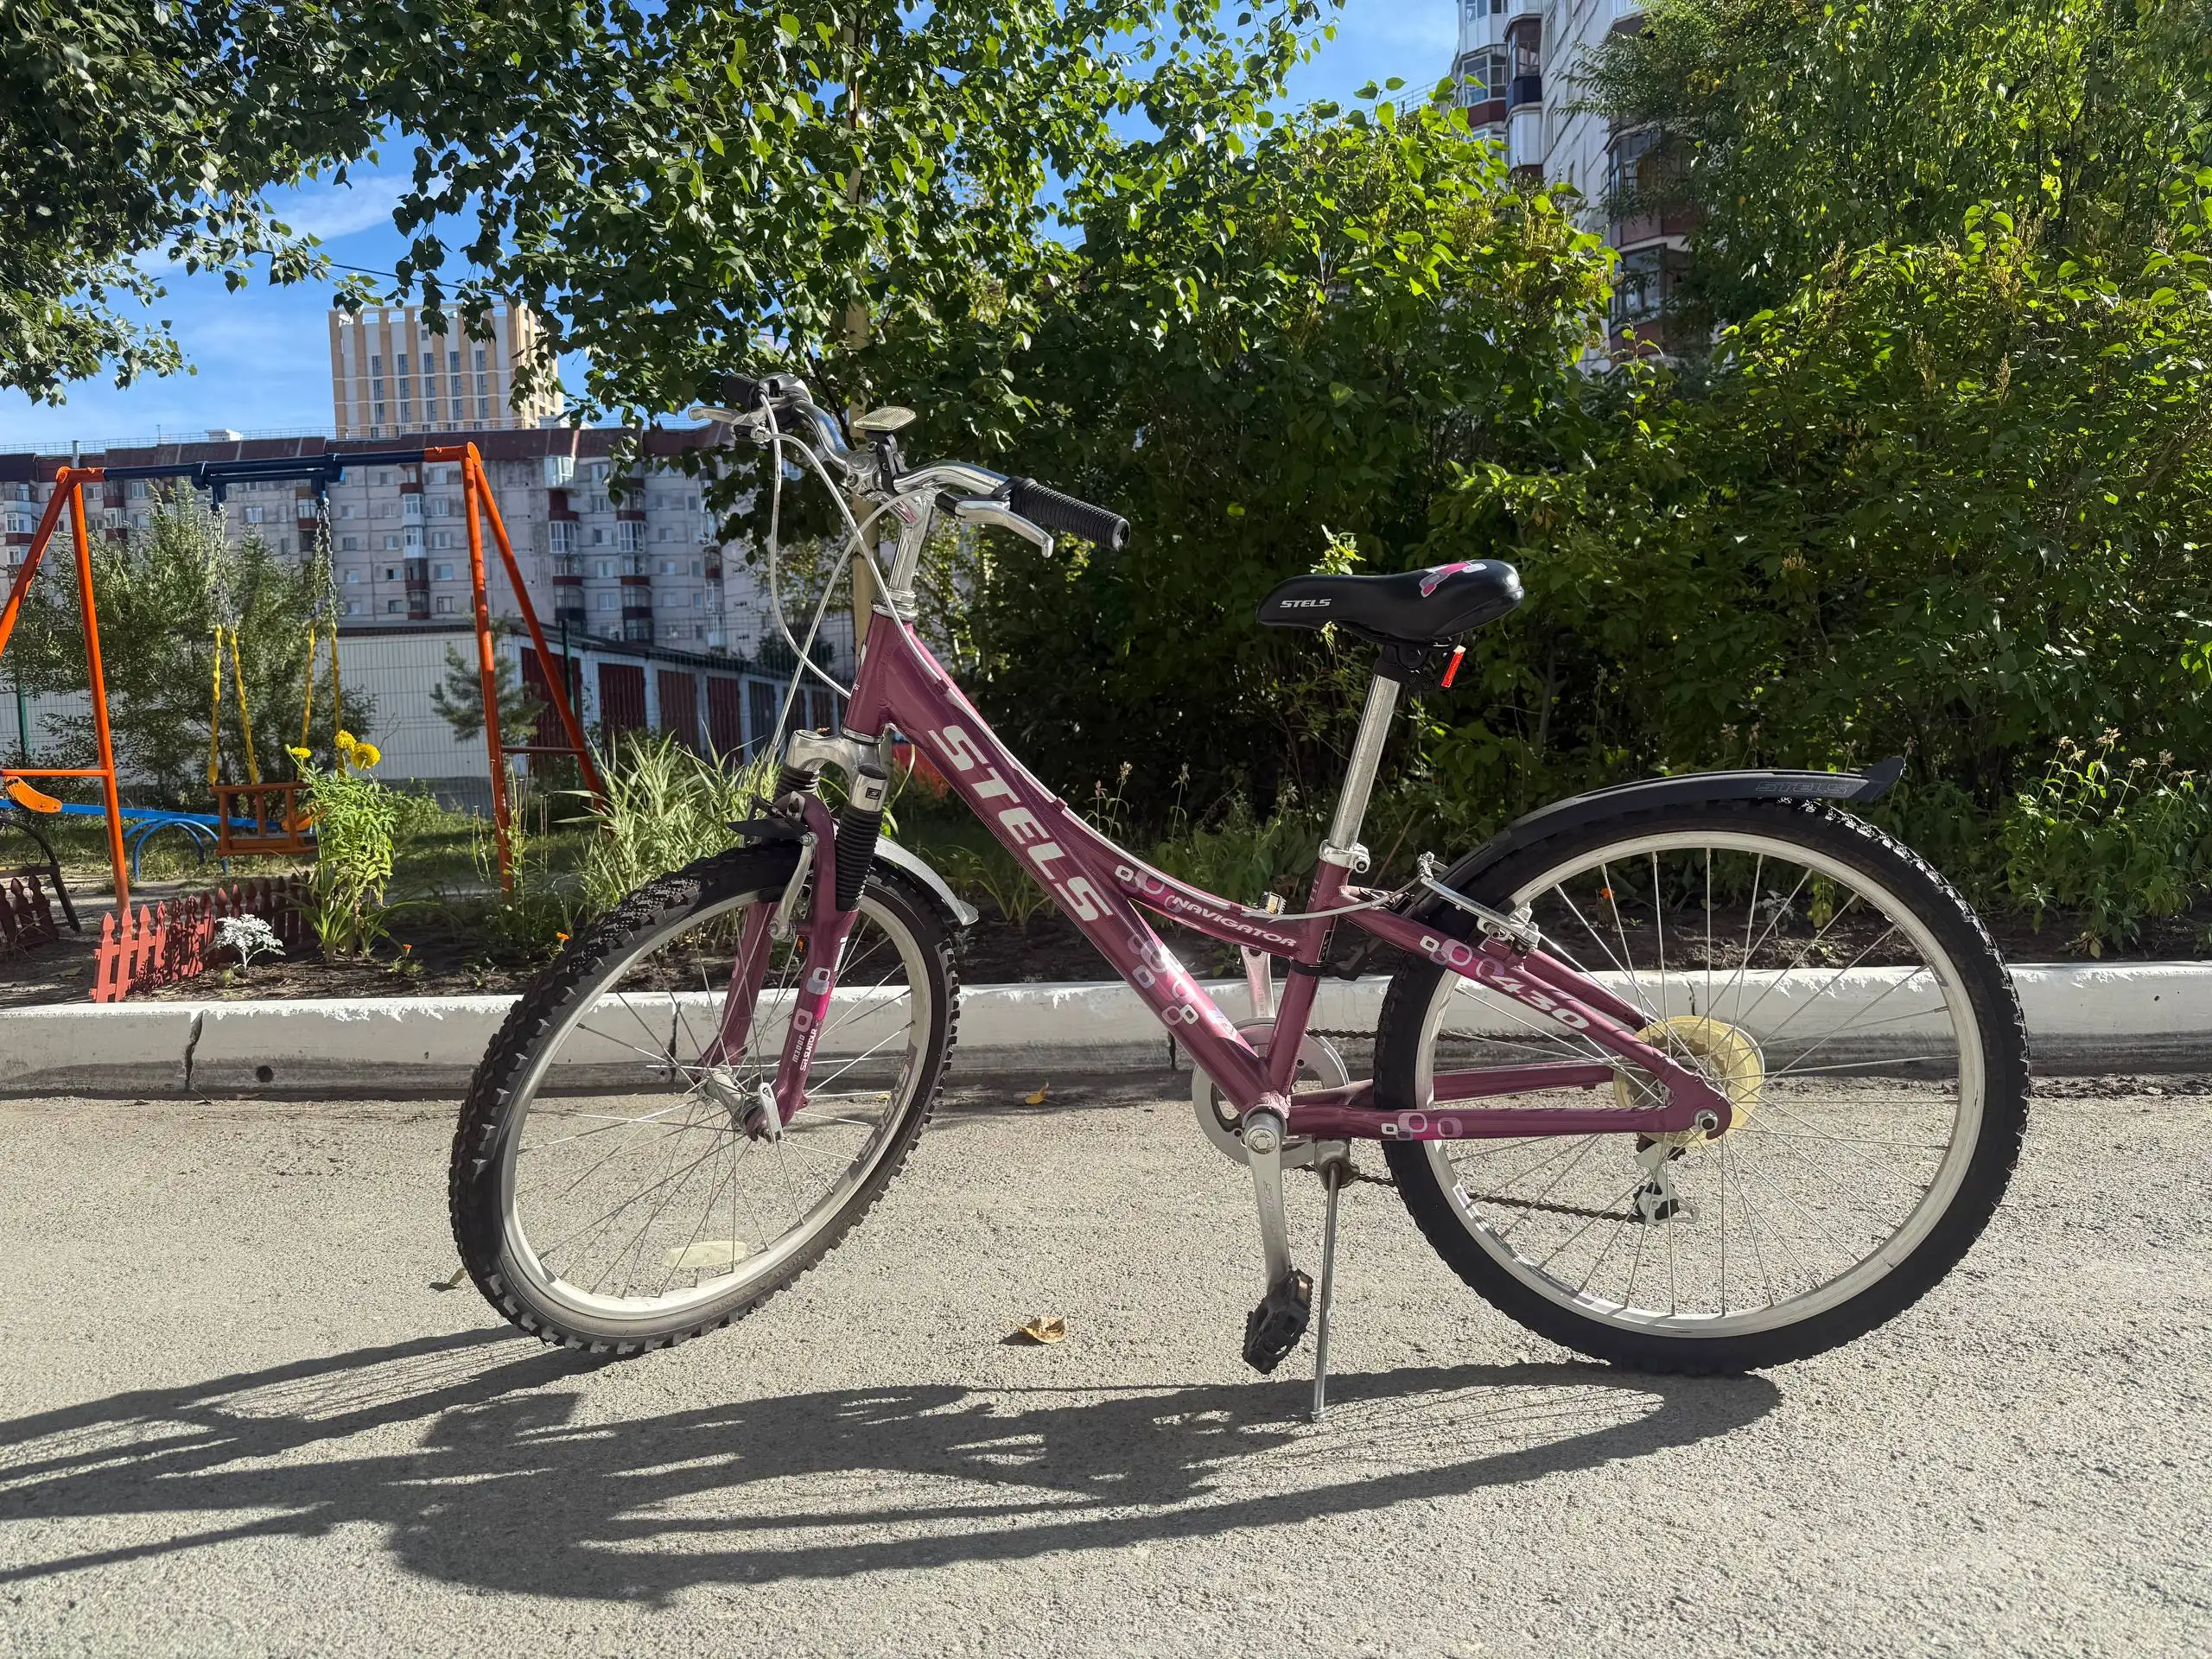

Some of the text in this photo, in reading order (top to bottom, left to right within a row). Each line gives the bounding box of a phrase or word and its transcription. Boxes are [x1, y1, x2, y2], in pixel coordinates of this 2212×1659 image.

[1280, 599, 1332, 608] STELS
[927, 725, 1113, 921] STELS
[1173, 897, 1297, 947] NAVIGATOR
[1489, 974, 1590, 1029] 430
[792, 1034, 805, 1063] M3000
